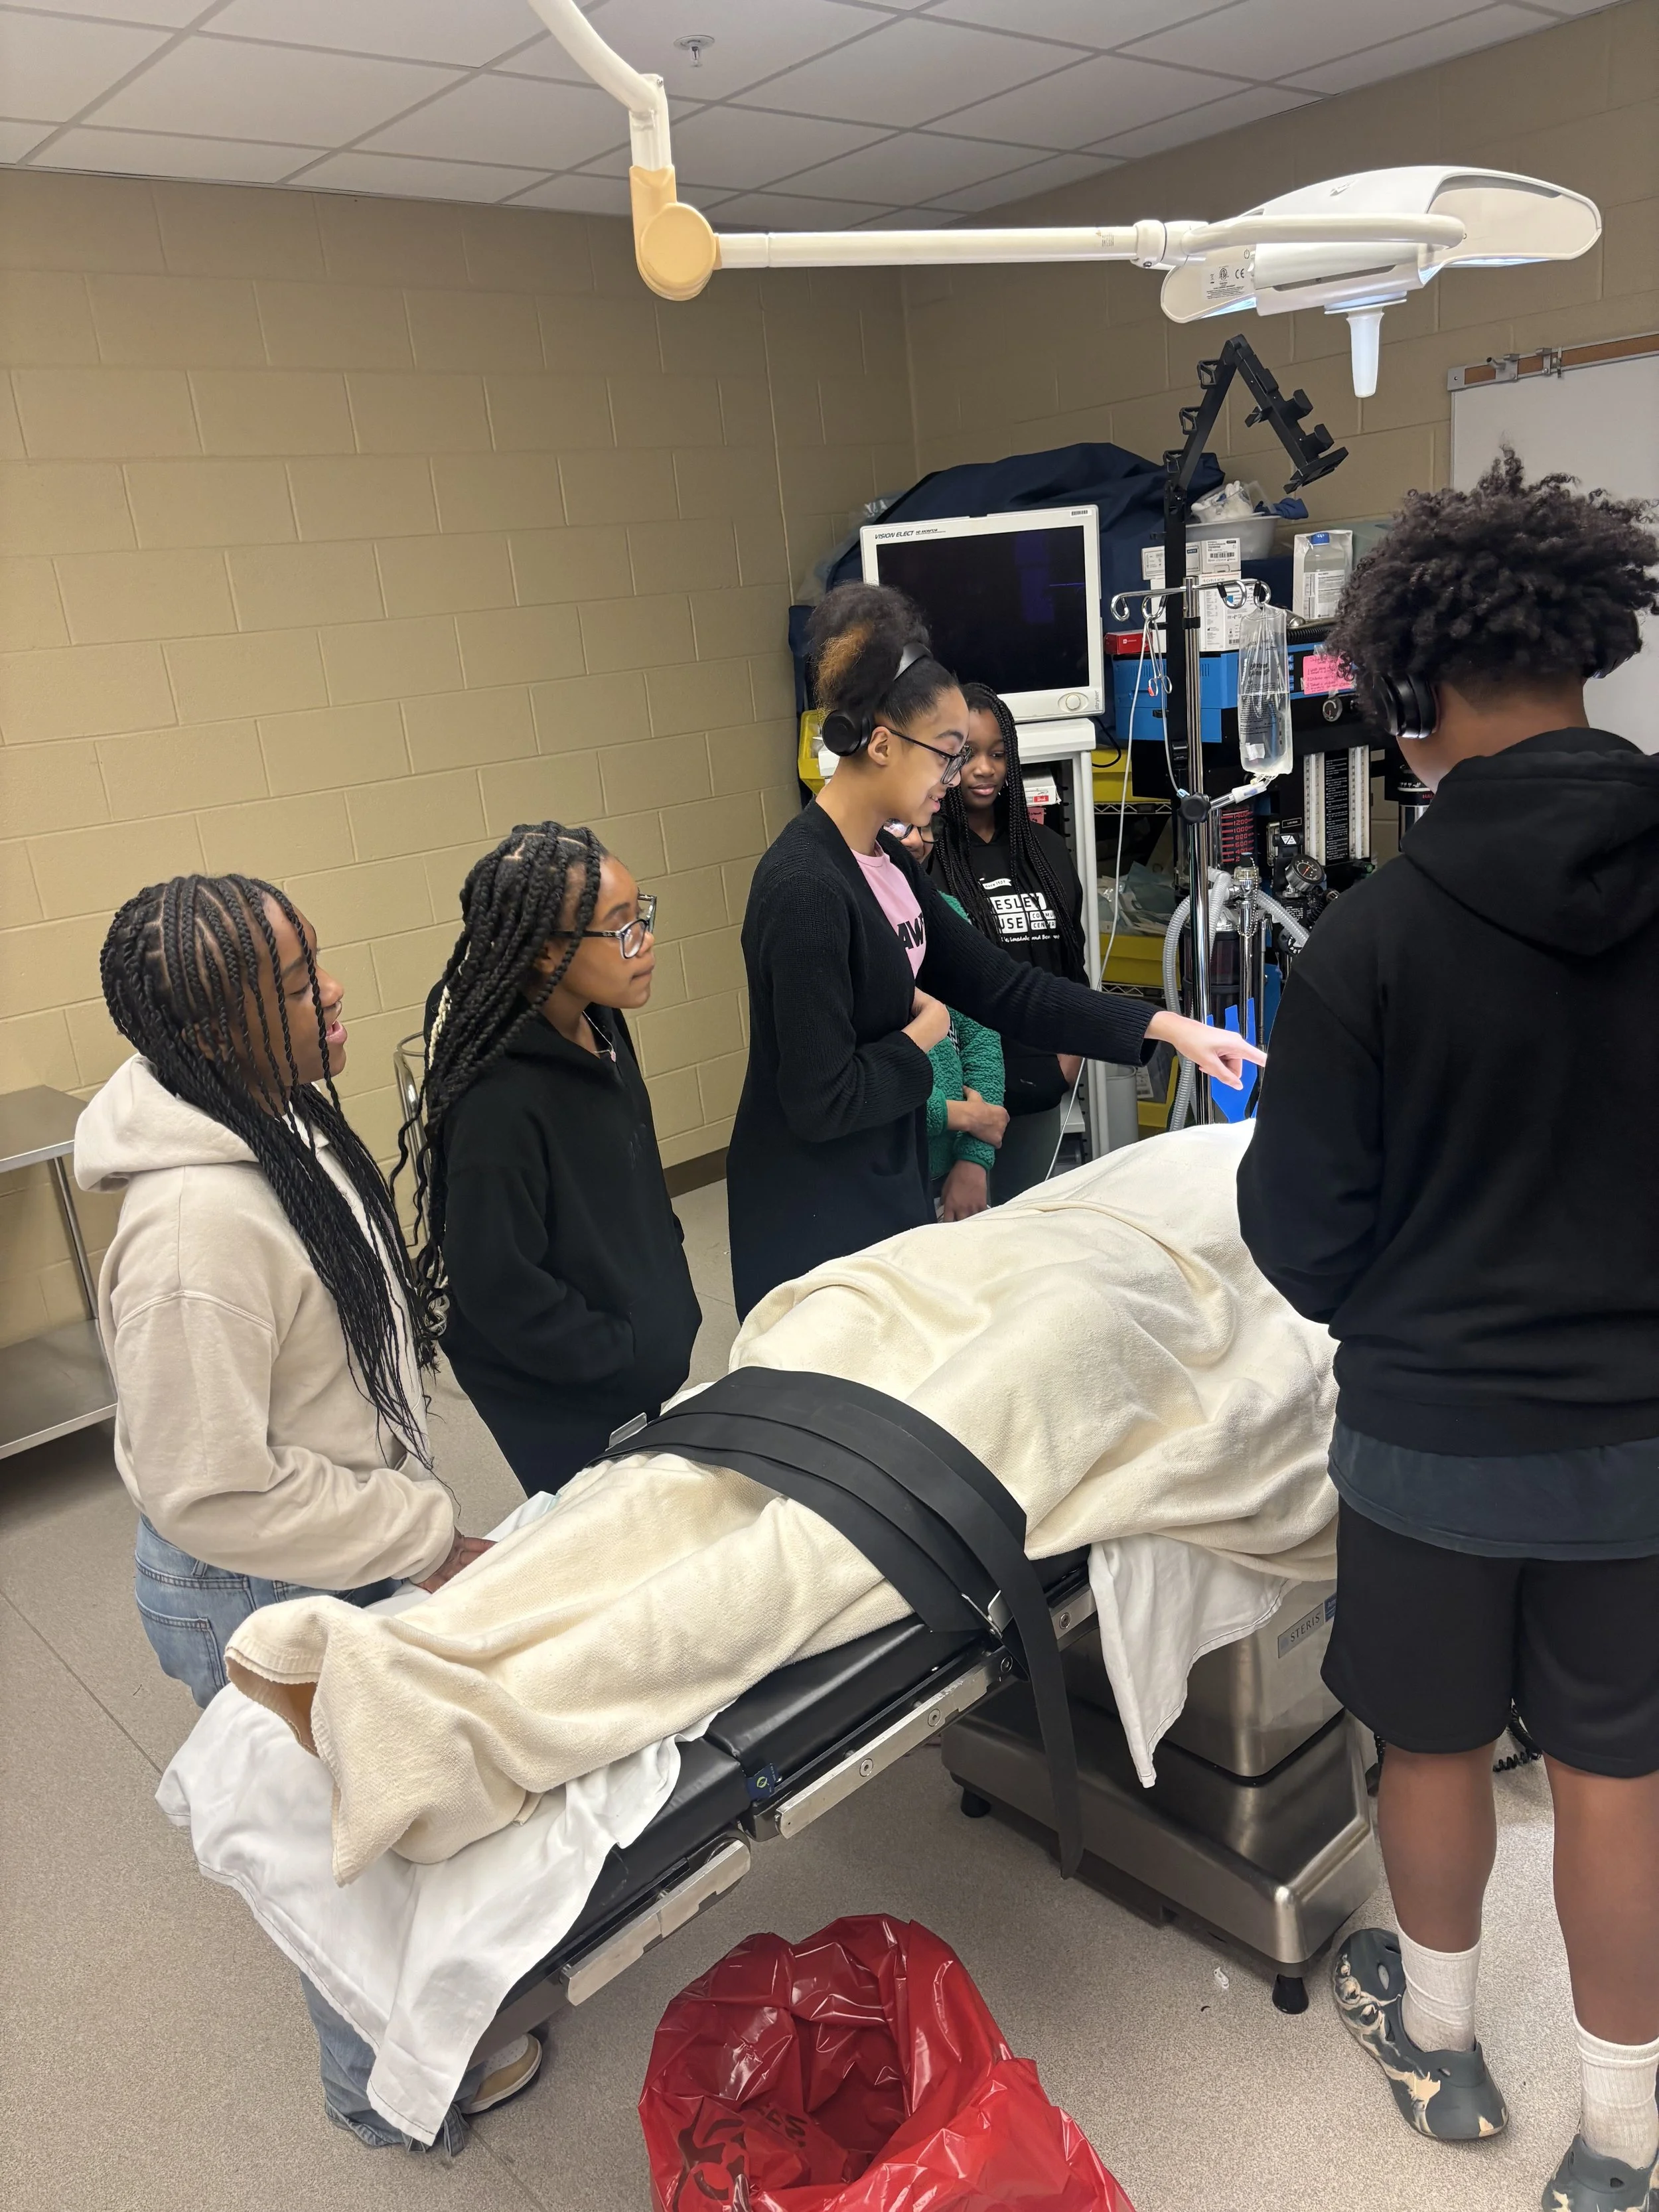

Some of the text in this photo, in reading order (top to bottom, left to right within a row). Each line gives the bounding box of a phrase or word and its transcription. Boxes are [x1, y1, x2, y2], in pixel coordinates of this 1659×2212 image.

[994, 895, 1041, 910] ESLEY
[999, 917, 1023, 929] USE
[1290, 1612, 1321, 1642] STERIS
